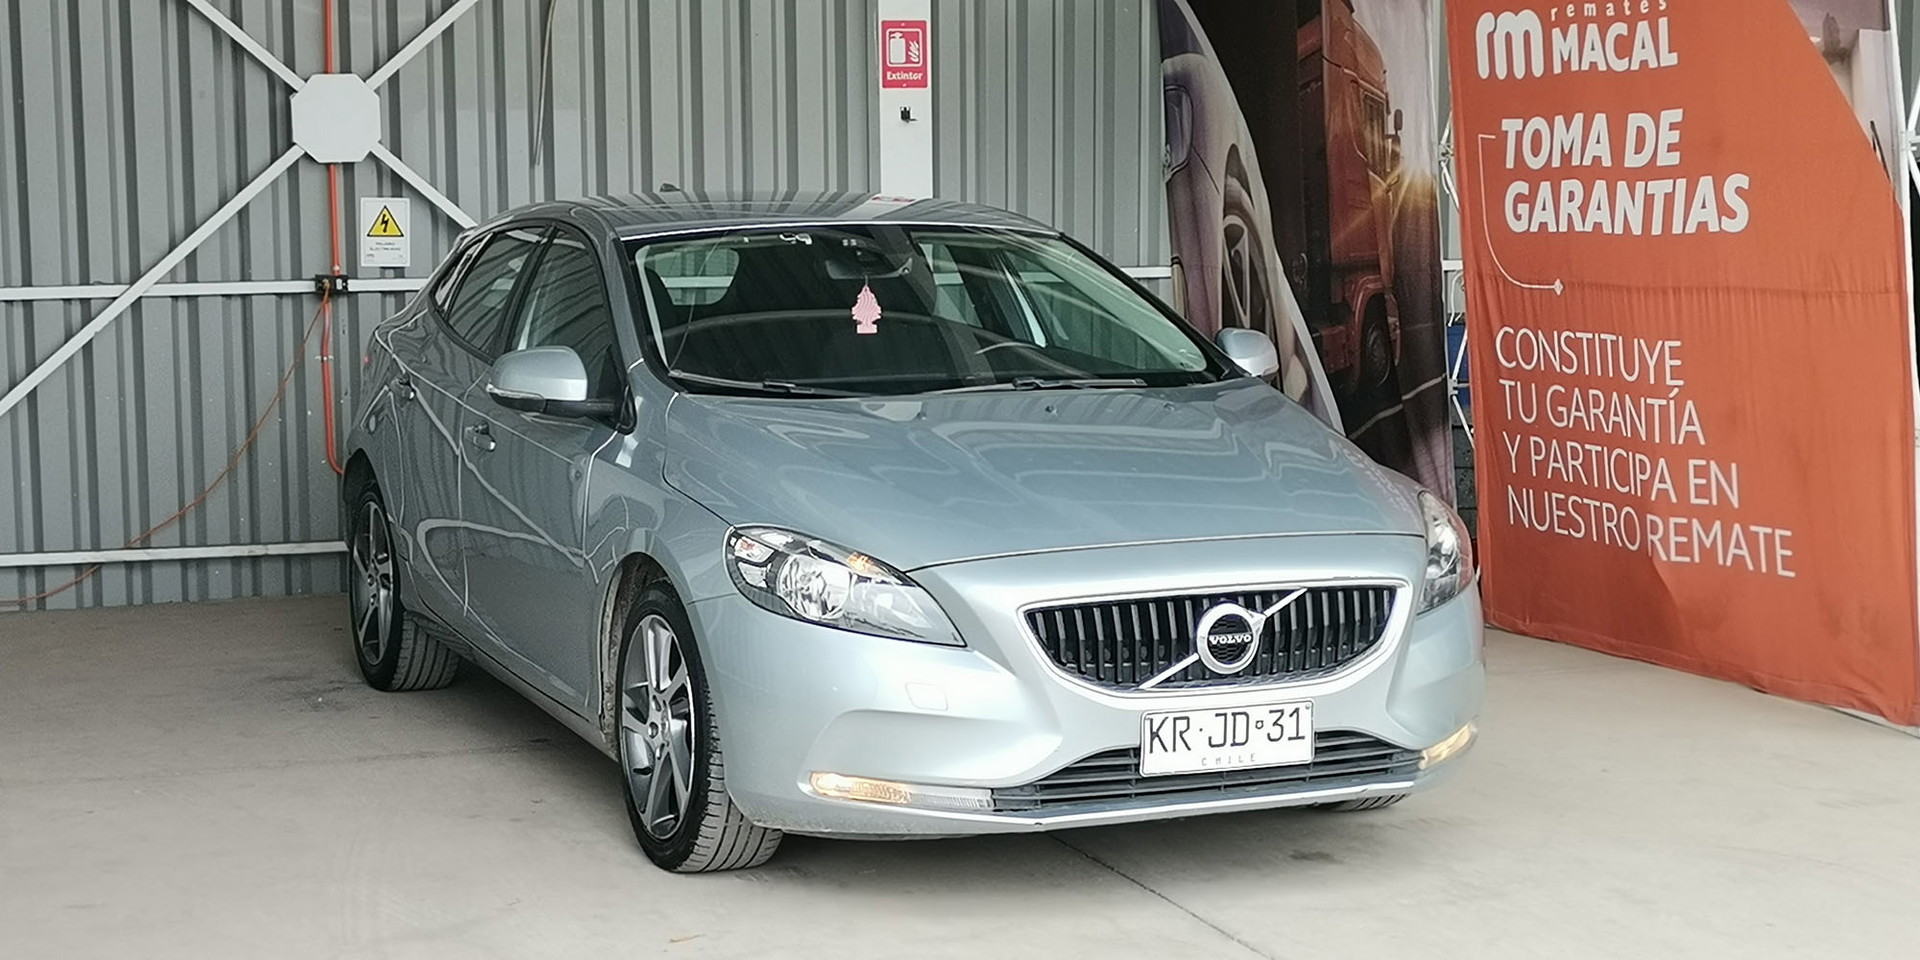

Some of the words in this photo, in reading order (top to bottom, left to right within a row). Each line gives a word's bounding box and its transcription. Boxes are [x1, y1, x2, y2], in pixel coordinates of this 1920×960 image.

[1551, 0, 1667, 21] remates
[1552, 16, 1678, 74] MACAL
[886, 71, 923, 80] Extintor
[1501, 112, 1612, 169] TOMA
[1624, 108, 1683, 167] DE
[1504, 173, 1750, 235] GARANTIAS
[1495, 326, 1684, 386] CONSTITUYE
[1499, 378, 1537, 423] TU
[1546, 384, 1706, 445] GARANTÍA
[1503, 431, 1521, 473] Y
[1531, 436, 1677, 503] PARTICIPA
[1688, 459, 1739, 508] EN
[1507, 485, 1640, 551] NUESTRO
[1647, 514, 1796, 577] REMATE
[1209, 634, 1252, 645] VOLVO
[1201, 753, 1256, 766] CHILE
